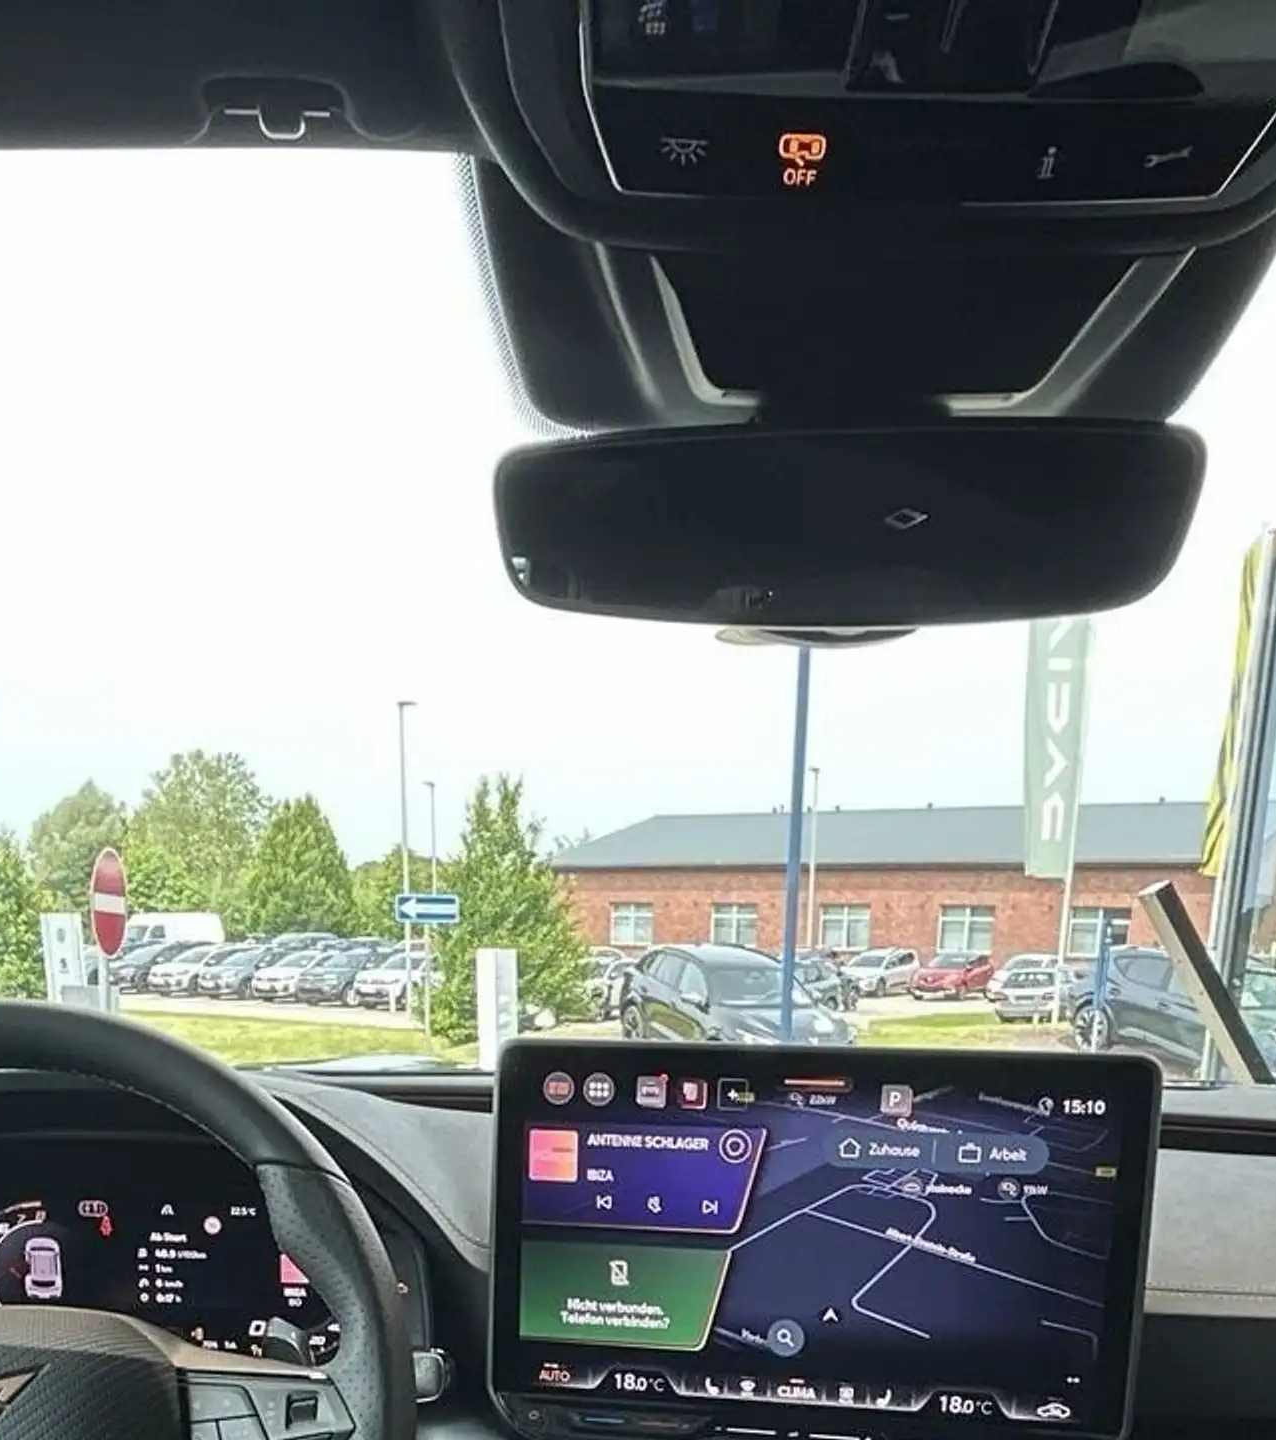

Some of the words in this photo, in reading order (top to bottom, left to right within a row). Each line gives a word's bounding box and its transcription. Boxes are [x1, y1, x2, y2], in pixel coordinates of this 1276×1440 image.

[783, 168, 817, 186] OFF
[1062, 1099, 1106, 1115] 15:10
[587, 1133, 643, 1149] ANTENNE
[645, 1135, 709, 1151] SCHLAGER
[869, 1142, 921, 1157] Zuhause
[989, 1147, 1028, 1162] Arbeit
[560, 1311, 604, 1325] Telefon
[538, 1368, 571, 1383] AUTO
[777, 1385, 817, 1400] CLIMA
